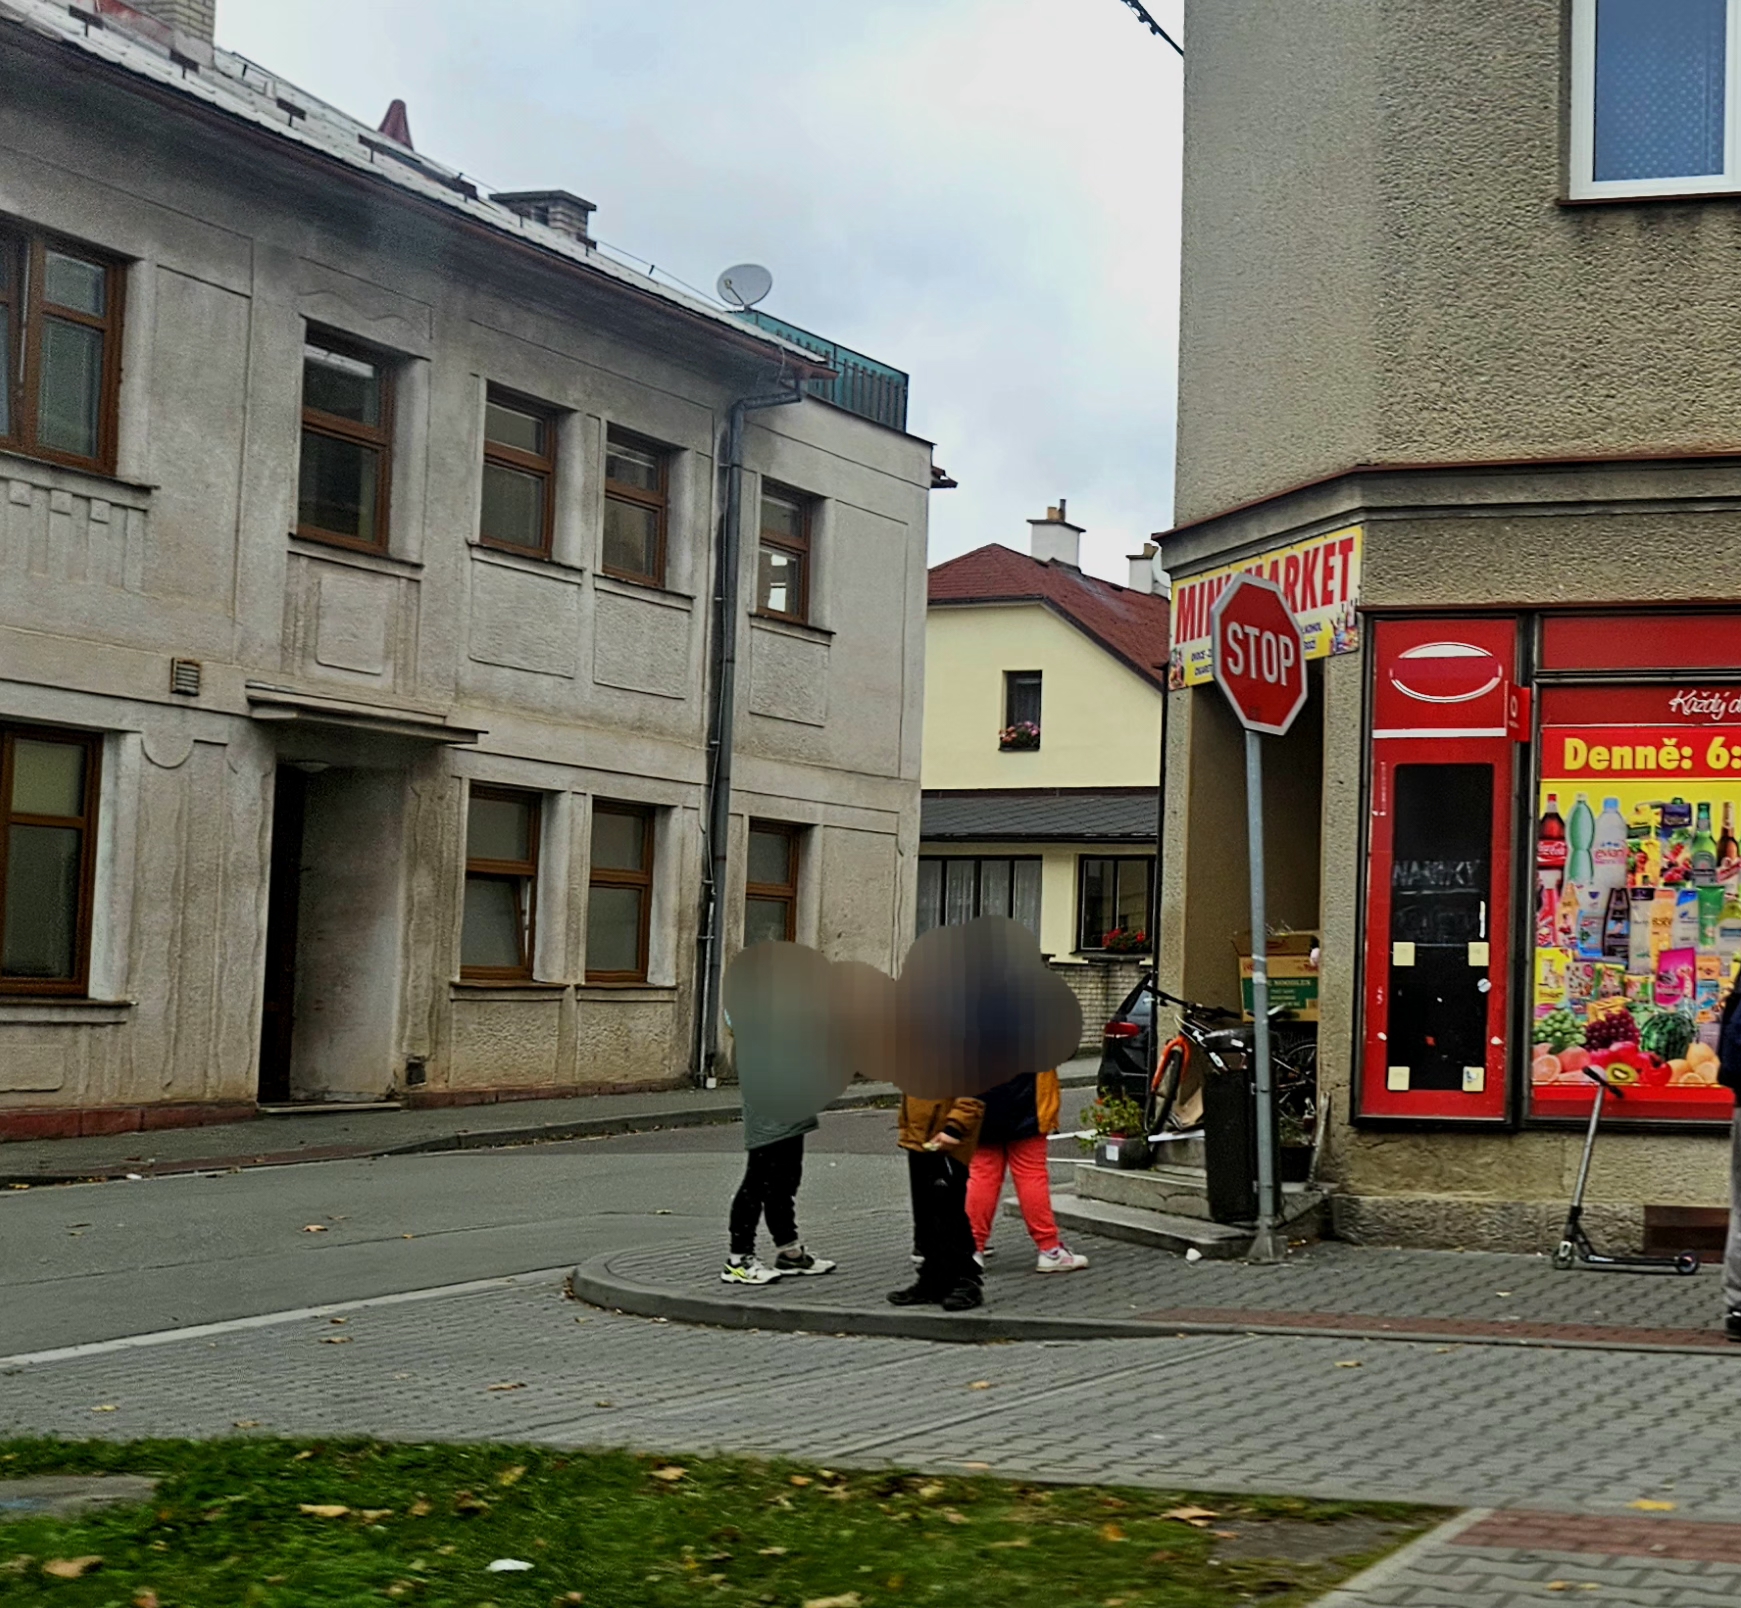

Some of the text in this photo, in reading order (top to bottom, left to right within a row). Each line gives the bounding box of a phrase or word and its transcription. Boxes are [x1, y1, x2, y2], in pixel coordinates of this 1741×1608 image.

[1175, 537, 1354, 645] MIN RKET
[1226, 621, 1294, 687] STOP
[1668, 689, 1730, 721] Každý
[1563, 737, 1693, 770] Denně:
